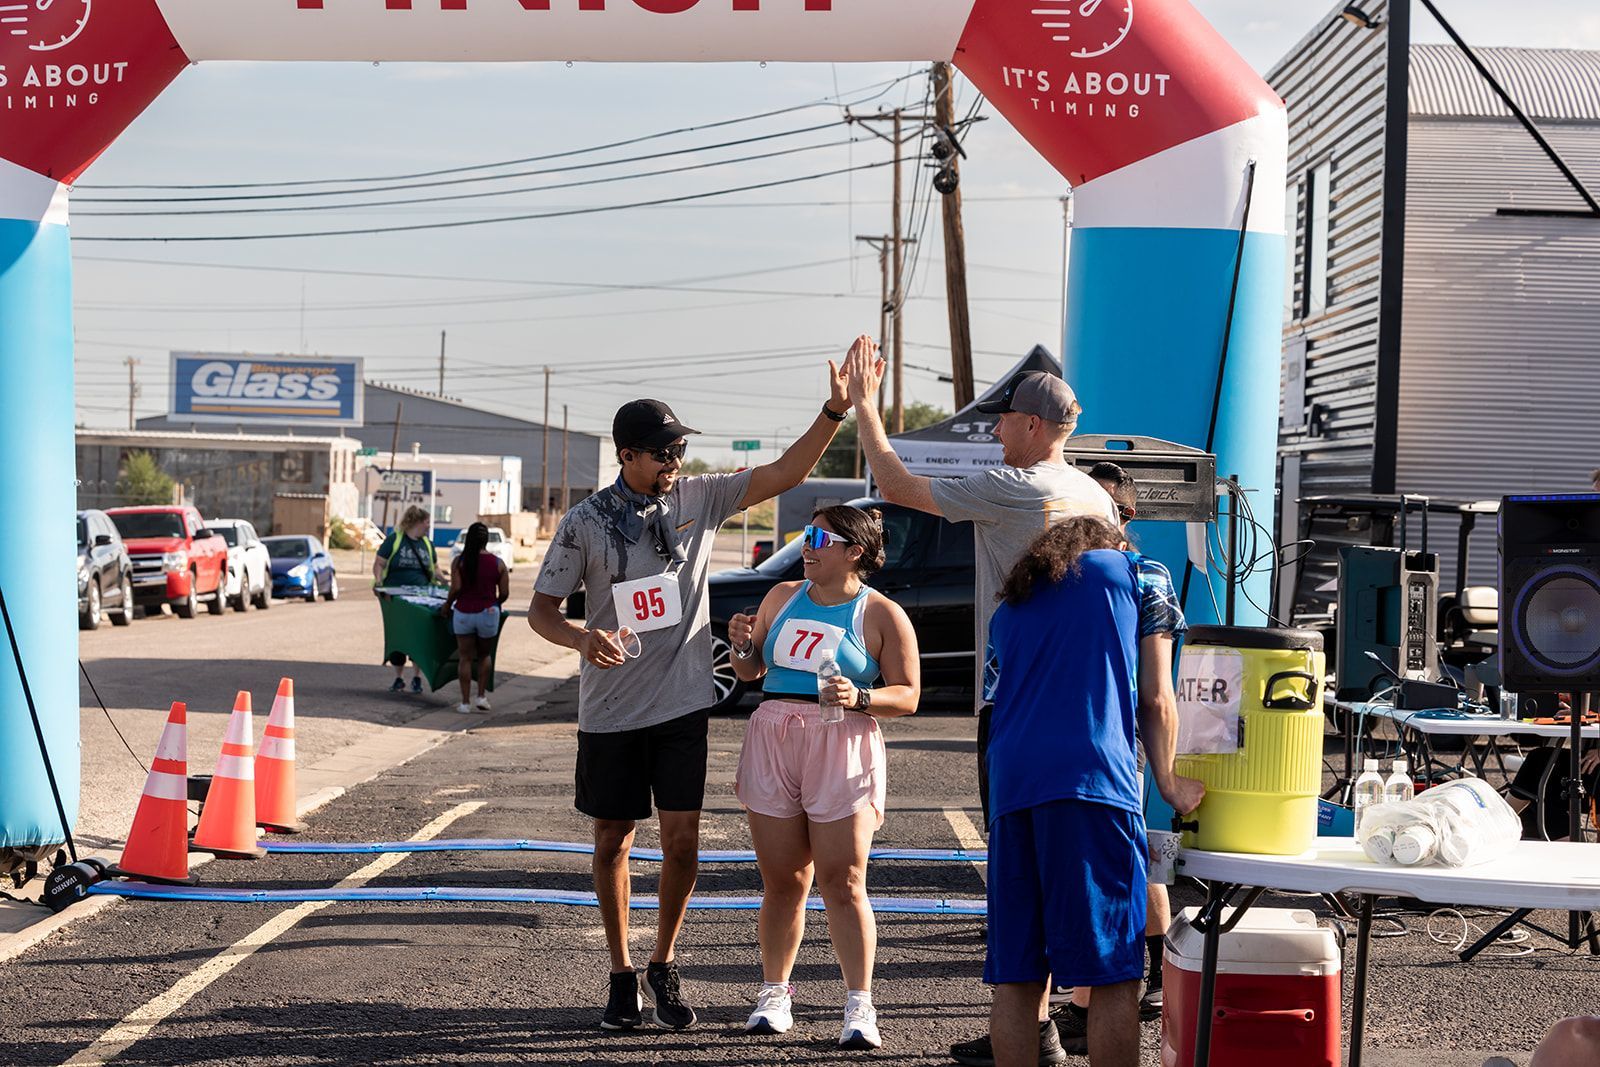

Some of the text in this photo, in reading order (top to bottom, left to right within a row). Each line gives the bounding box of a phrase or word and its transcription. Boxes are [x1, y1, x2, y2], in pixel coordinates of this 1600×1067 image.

[22, 61, 129, 88] ABOUT
[1003, 66, 1171, 97] IT'S ABOUT
[7, 92, 98, 109] IMING
[1031, 97, 1140, 118] TIMING
[191, 361, 341, 401] Glass
[950, 420, 1001, 434] ST
[925, 456, 961, 465] ENERGY
[972, 459, 1005, 467] EVENTS
[1136, 487, 1179, 501] clock.
[632, 586, 666, 621] 95
[789, 629, 825, 660] 77
[1177, 678, 1230, 704] ATER
